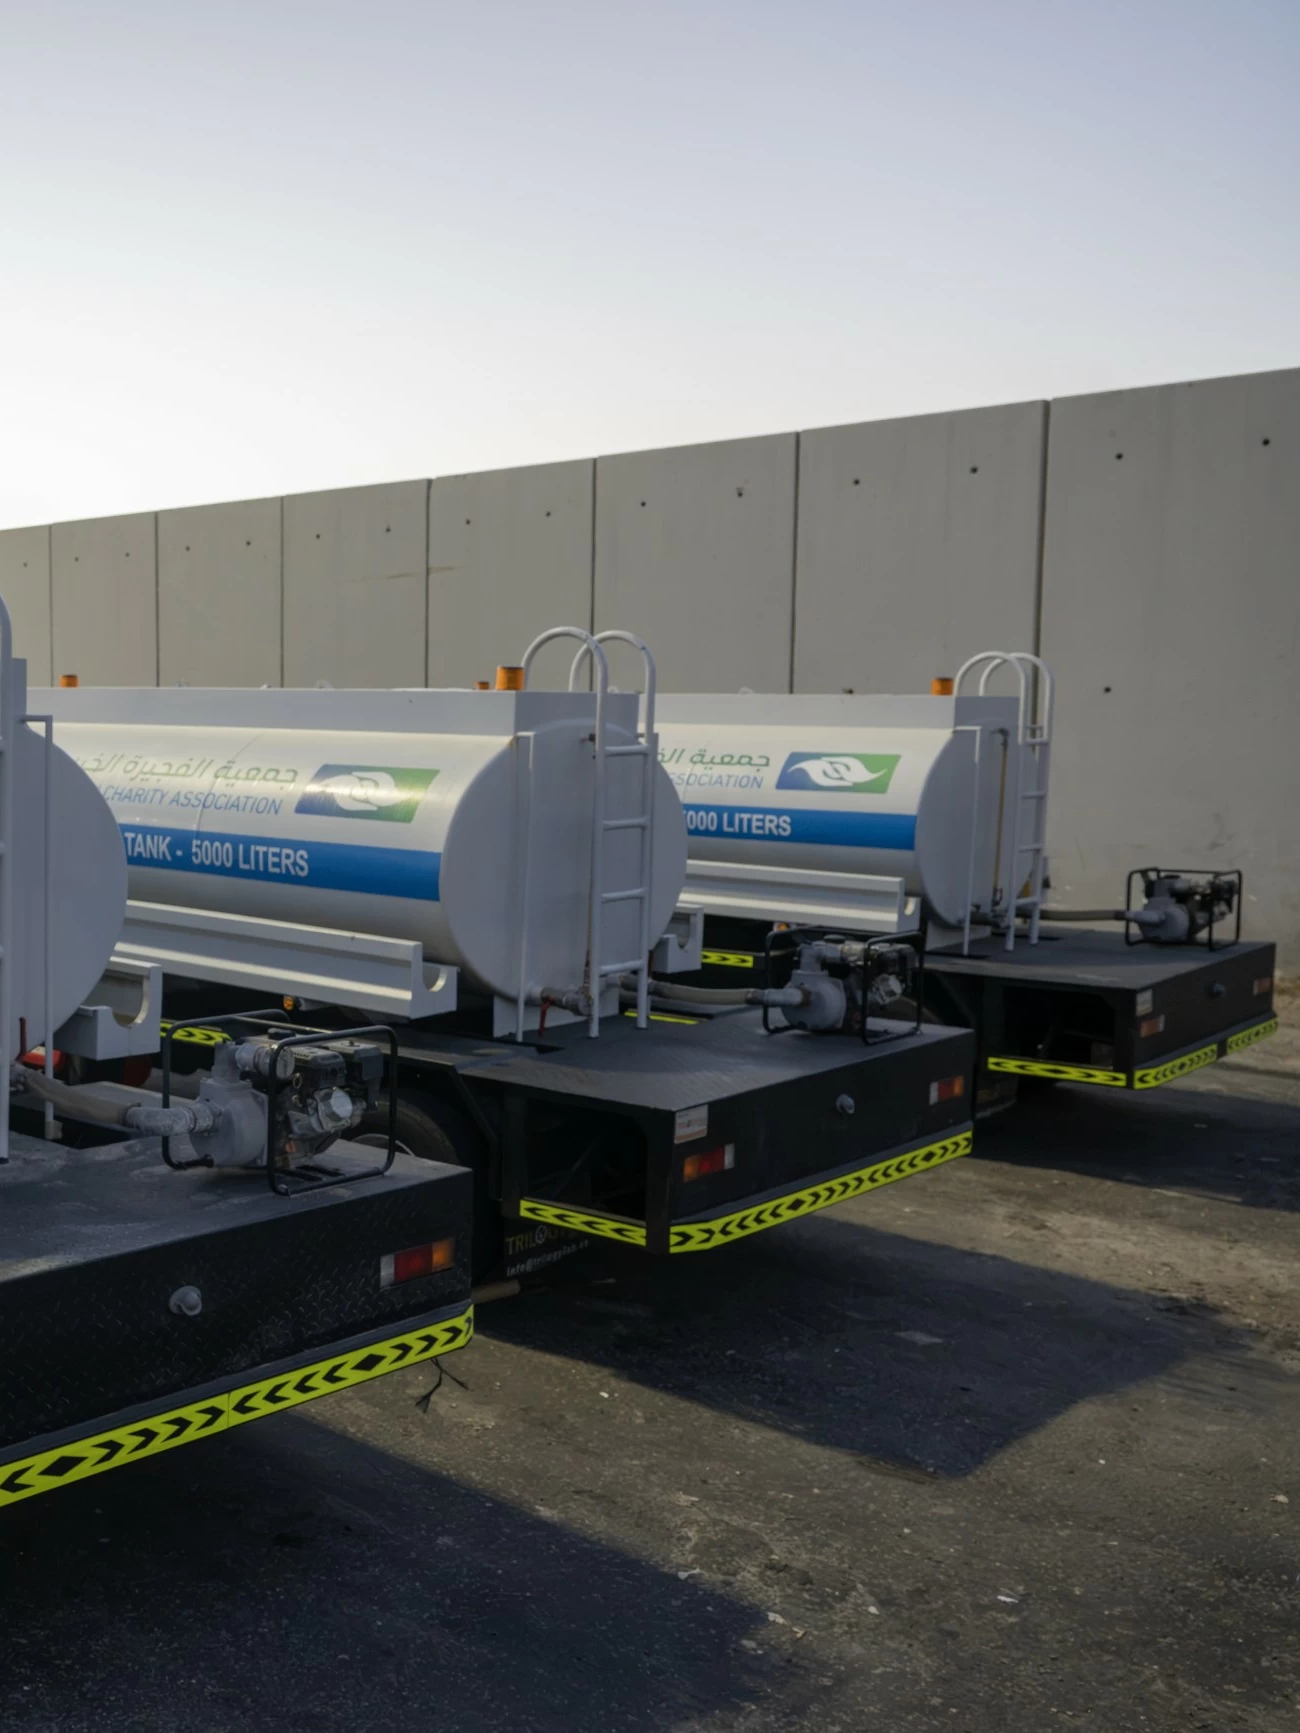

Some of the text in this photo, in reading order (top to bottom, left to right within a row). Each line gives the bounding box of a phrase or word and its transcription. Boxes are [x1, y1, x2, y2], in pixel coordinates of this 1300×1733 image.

[123, 755, 214, 782] الفجيرة
[213, 759, 298, 790] جمعية
[690, 748, 770, 772] جمعية
[103, 784, 284, 815] CHARITY ASSOCIATION
[684, 810, 792, 836] 000 LITERS
[124, 832, 172, 861] TANK
[191, 839, 233, 868] 5000
[238, 843, 309, 877] LITERS
